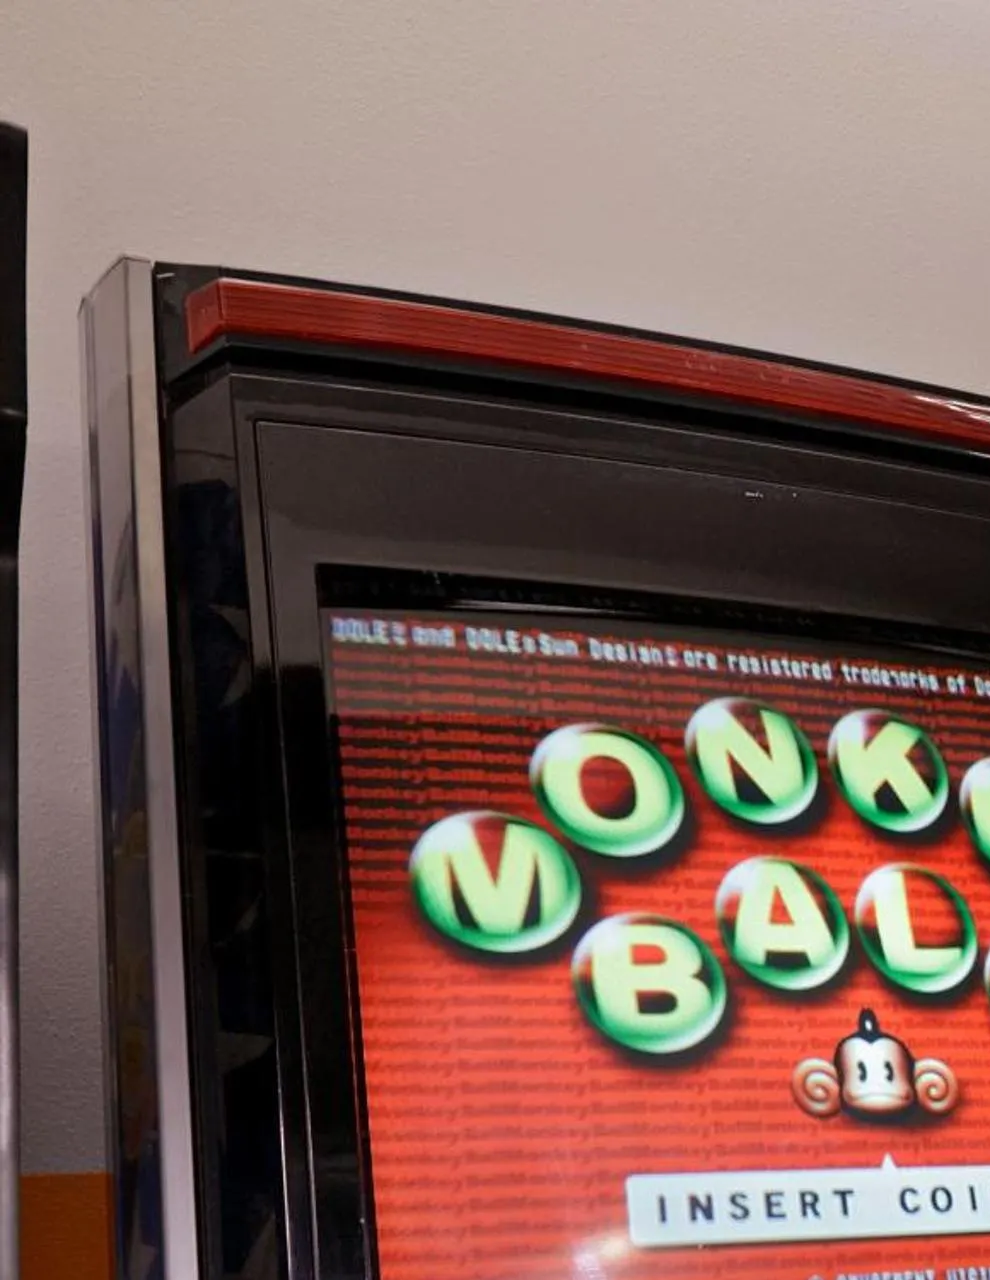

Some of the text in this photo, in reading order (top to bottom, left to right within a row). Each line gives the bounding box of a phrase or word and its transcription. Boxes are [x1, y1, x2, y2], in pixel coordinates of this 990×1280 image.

[683, 650, 718, 670] are
[727, 653, 832, 682] registered
[947, 674, 965, 693] of
[657, 1189, 855, 1223] INSERT
